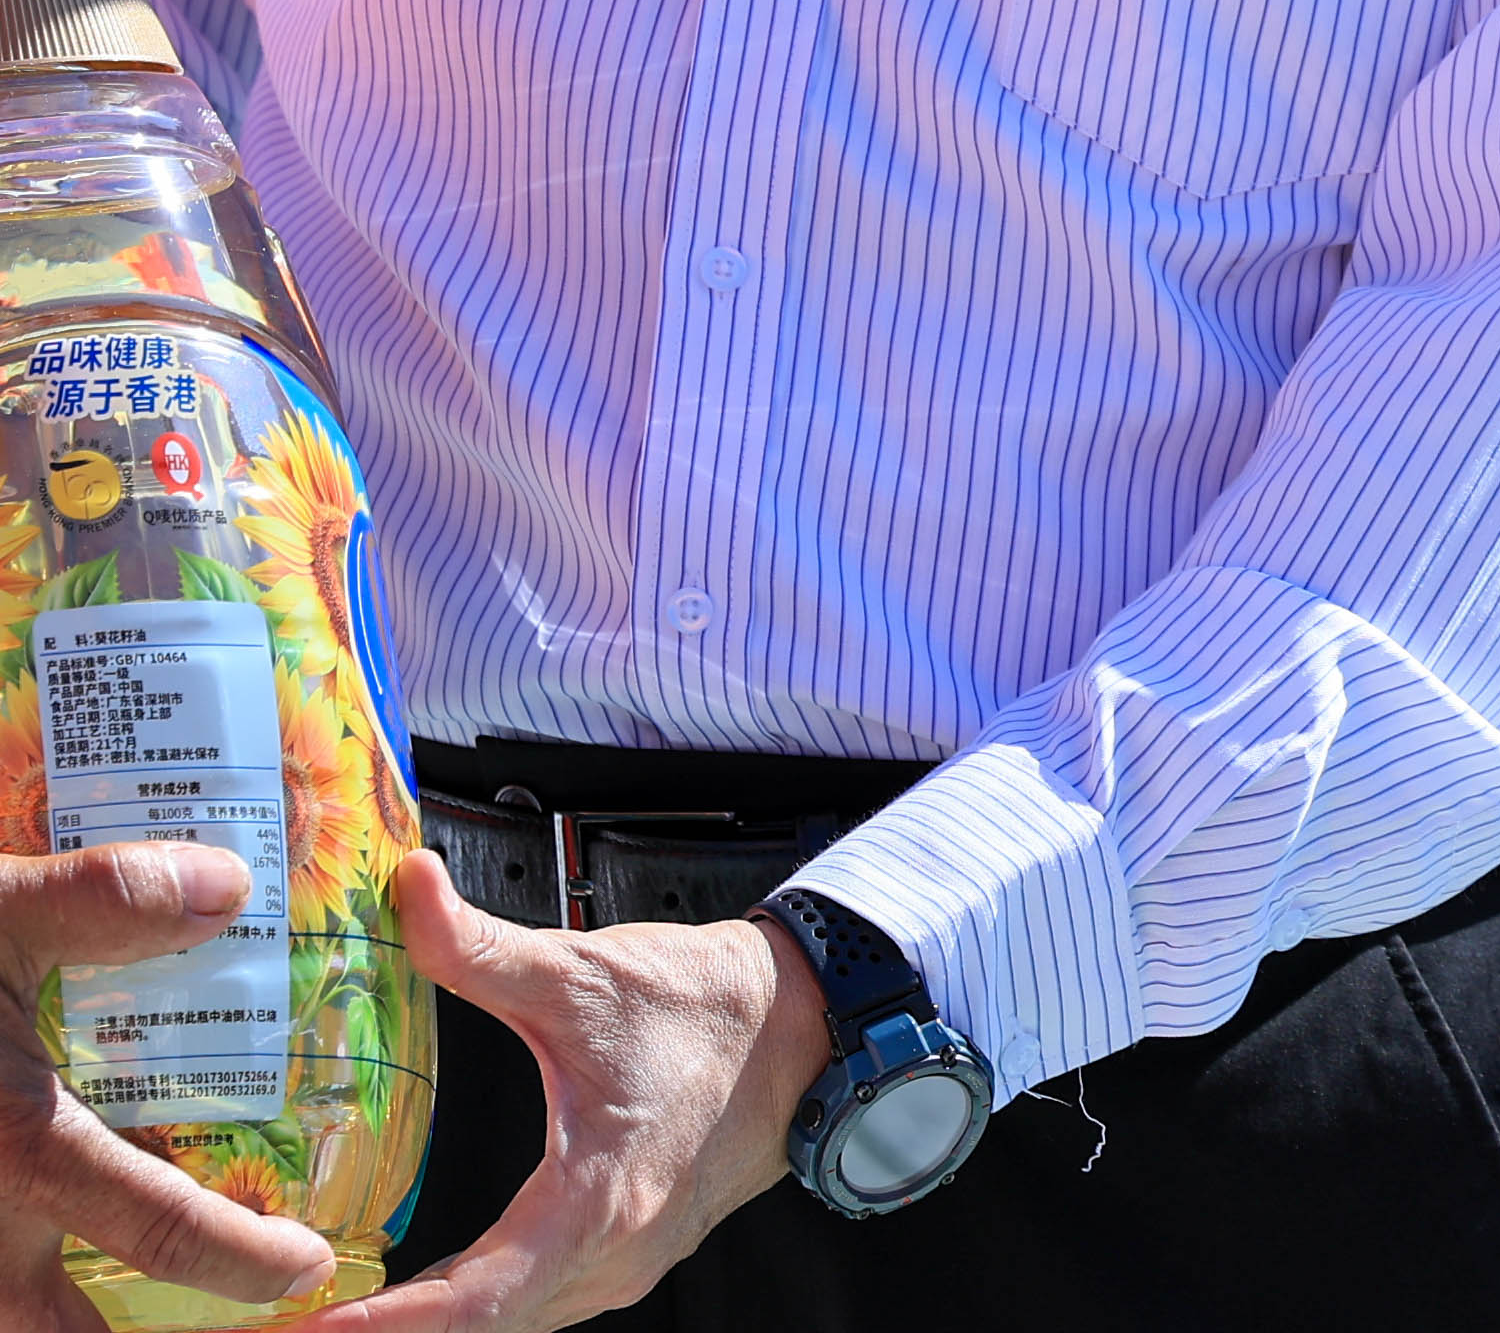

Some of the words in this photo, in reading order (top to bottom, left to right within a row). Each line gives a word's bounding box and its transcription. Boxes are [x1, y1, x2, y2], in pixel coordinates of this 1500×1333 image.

[28, 336, 174, 375] 品味健康
[45, 374, 196, 418] 源于香港
[78, 507, 127, 534] PREMIER
[143, 509, 228, 526] Q唛优质产品
[44, 637, 57, 650] 配
[150, 652, 188, 664] 10464
[48, 668, 130, 686] 质量等级:一级
[49, 680, 144, 699] 产品原产国:中国
[50, 693, 183, 713] 食品产地:广东省深圳市
[51, 707, 172, 728] 生产日期:见瓶身上部
[53, 722, 135, 741] 加工工艺:压榨
[54, 736, 137, 755] 保质期:21个月
[137, 782, 201, 797] 营养成分表
[57, 814, 81, 828] 项目
[147, 807, 194, 821] 每100克
[207, 806, 278, 820] 营养素参考值%
[59, 836, 83, 849] 能量
[144, 829, 198, 842] 3700千焦
[256, 829, 279, 841] 44%
[263, 843, 280, 855] 0%
[253, 856, 280, 869] 167%
[265, 885, 282, 897] 0%
[265, 899, 282, 912] 0%
